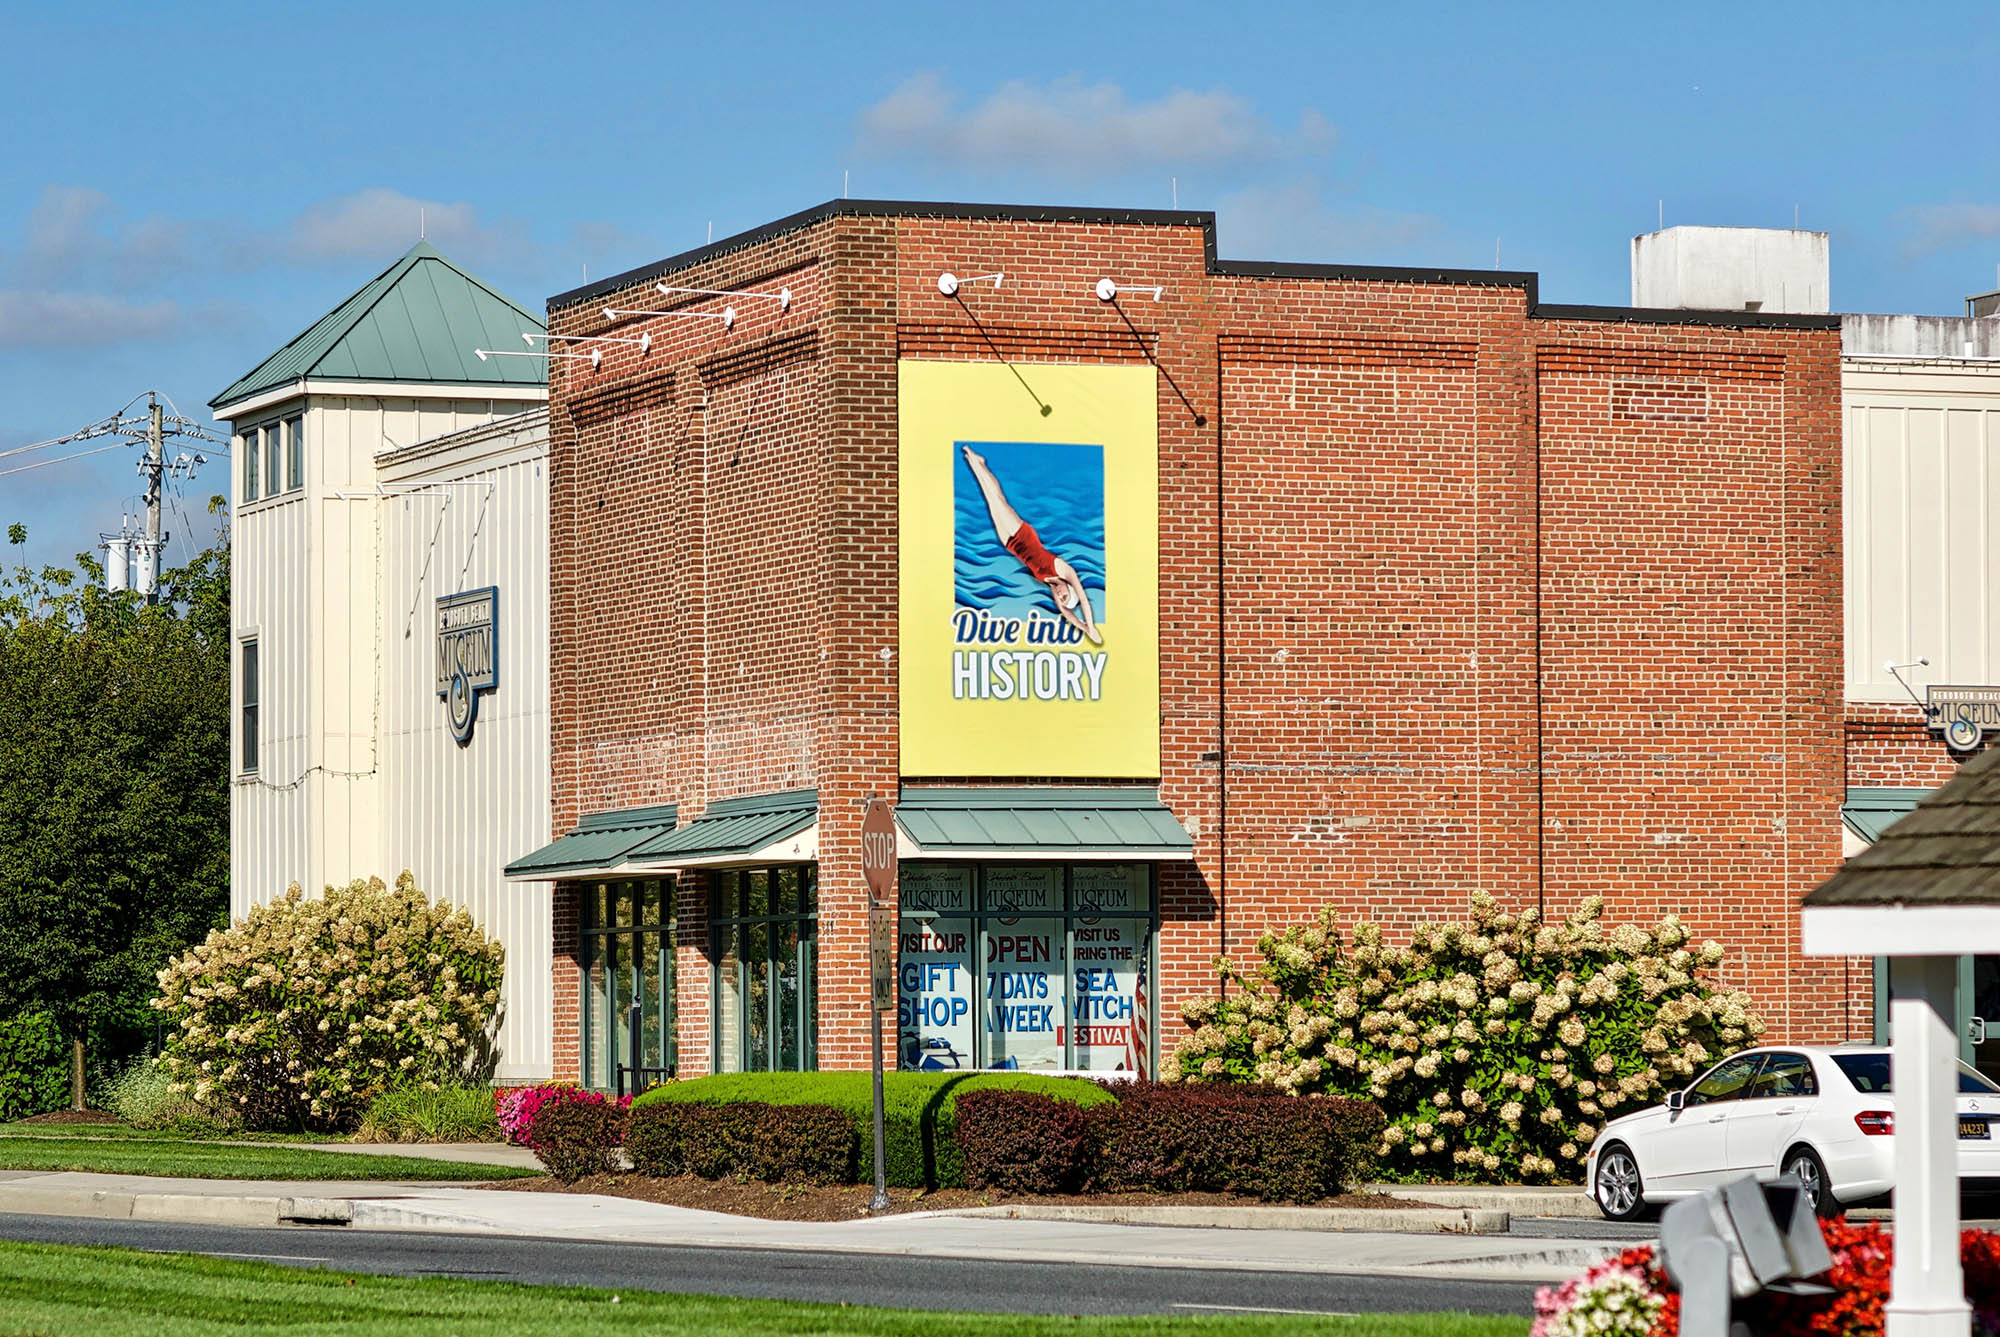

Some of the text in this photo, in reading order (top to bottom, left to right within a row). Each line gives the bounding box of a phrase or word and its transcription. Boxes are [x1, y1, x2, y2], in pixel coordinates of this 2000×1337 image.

[953, 609, 1084, 644] Dive into
[438, 626, 493, 683] MUSEUM
[953, 650, 1108, 700] HISTORY
[864, 832, 895, 869] STOP
[900, 889, 963, 908] MUSEUM
[901, 933, 967, 953] VISIT OUR
[1073, 928, 1120, 941] VISIT US
[1108, 946, 1133, 960] THE
[901, 962, 960, 992] GIFT
[987, 972, 1048, 999] 7 DAYS
[1075, 967, 1118, 992] SEA
[899, 997, 968, 1027] SHOP
[995, 1005, 1054, 1032] WEEK
